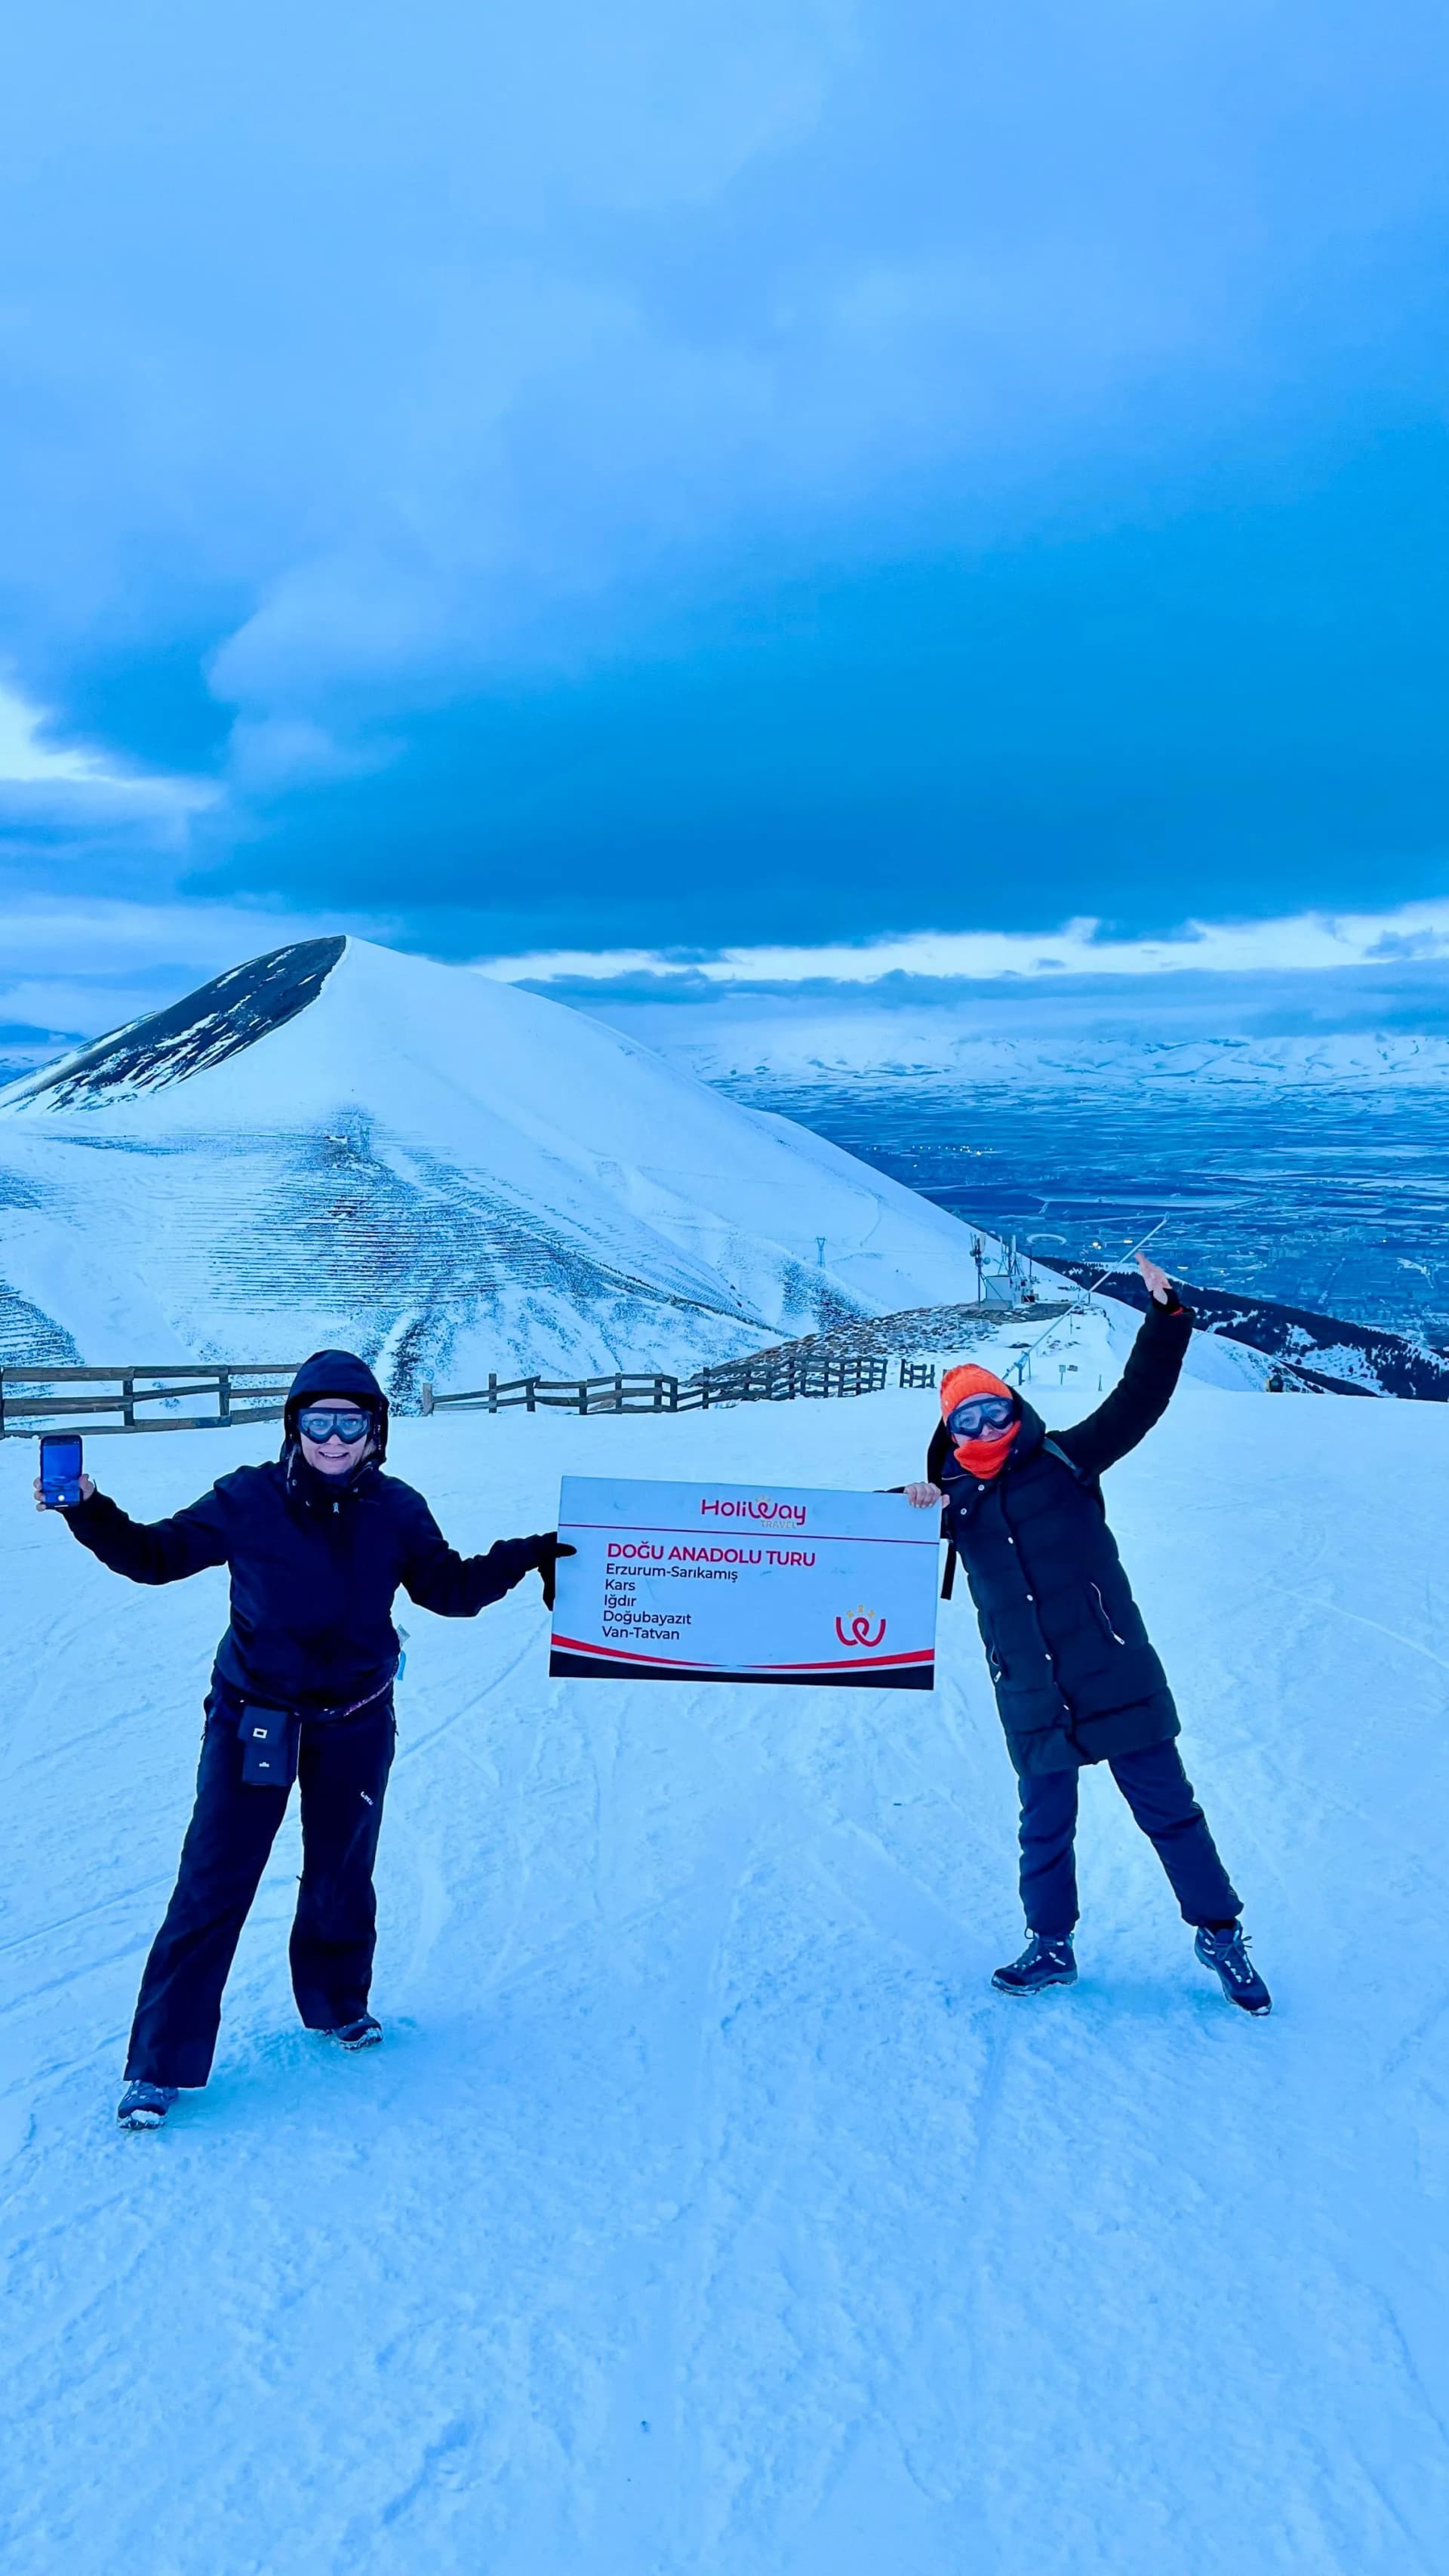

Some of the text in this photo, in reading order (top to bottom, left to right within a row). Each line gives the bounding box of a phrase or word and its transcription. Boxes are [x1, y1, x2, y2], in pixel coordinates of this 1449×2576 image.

[760, 1520, 797, 1529] TRAVEL
[607, 1541, 816, 1567] DOĞU ANADOLU TURU
[606, 1563, 738, 1583] Erzurum-Sarıkamış
[605, 1578, 635, 1591] Kars
[604, 1594, 637, 1608] Iğdır
[603, 1610, 692, 1627] Doğubayazıt
[601, 1626, 680, 1640] Van-Tatvan
